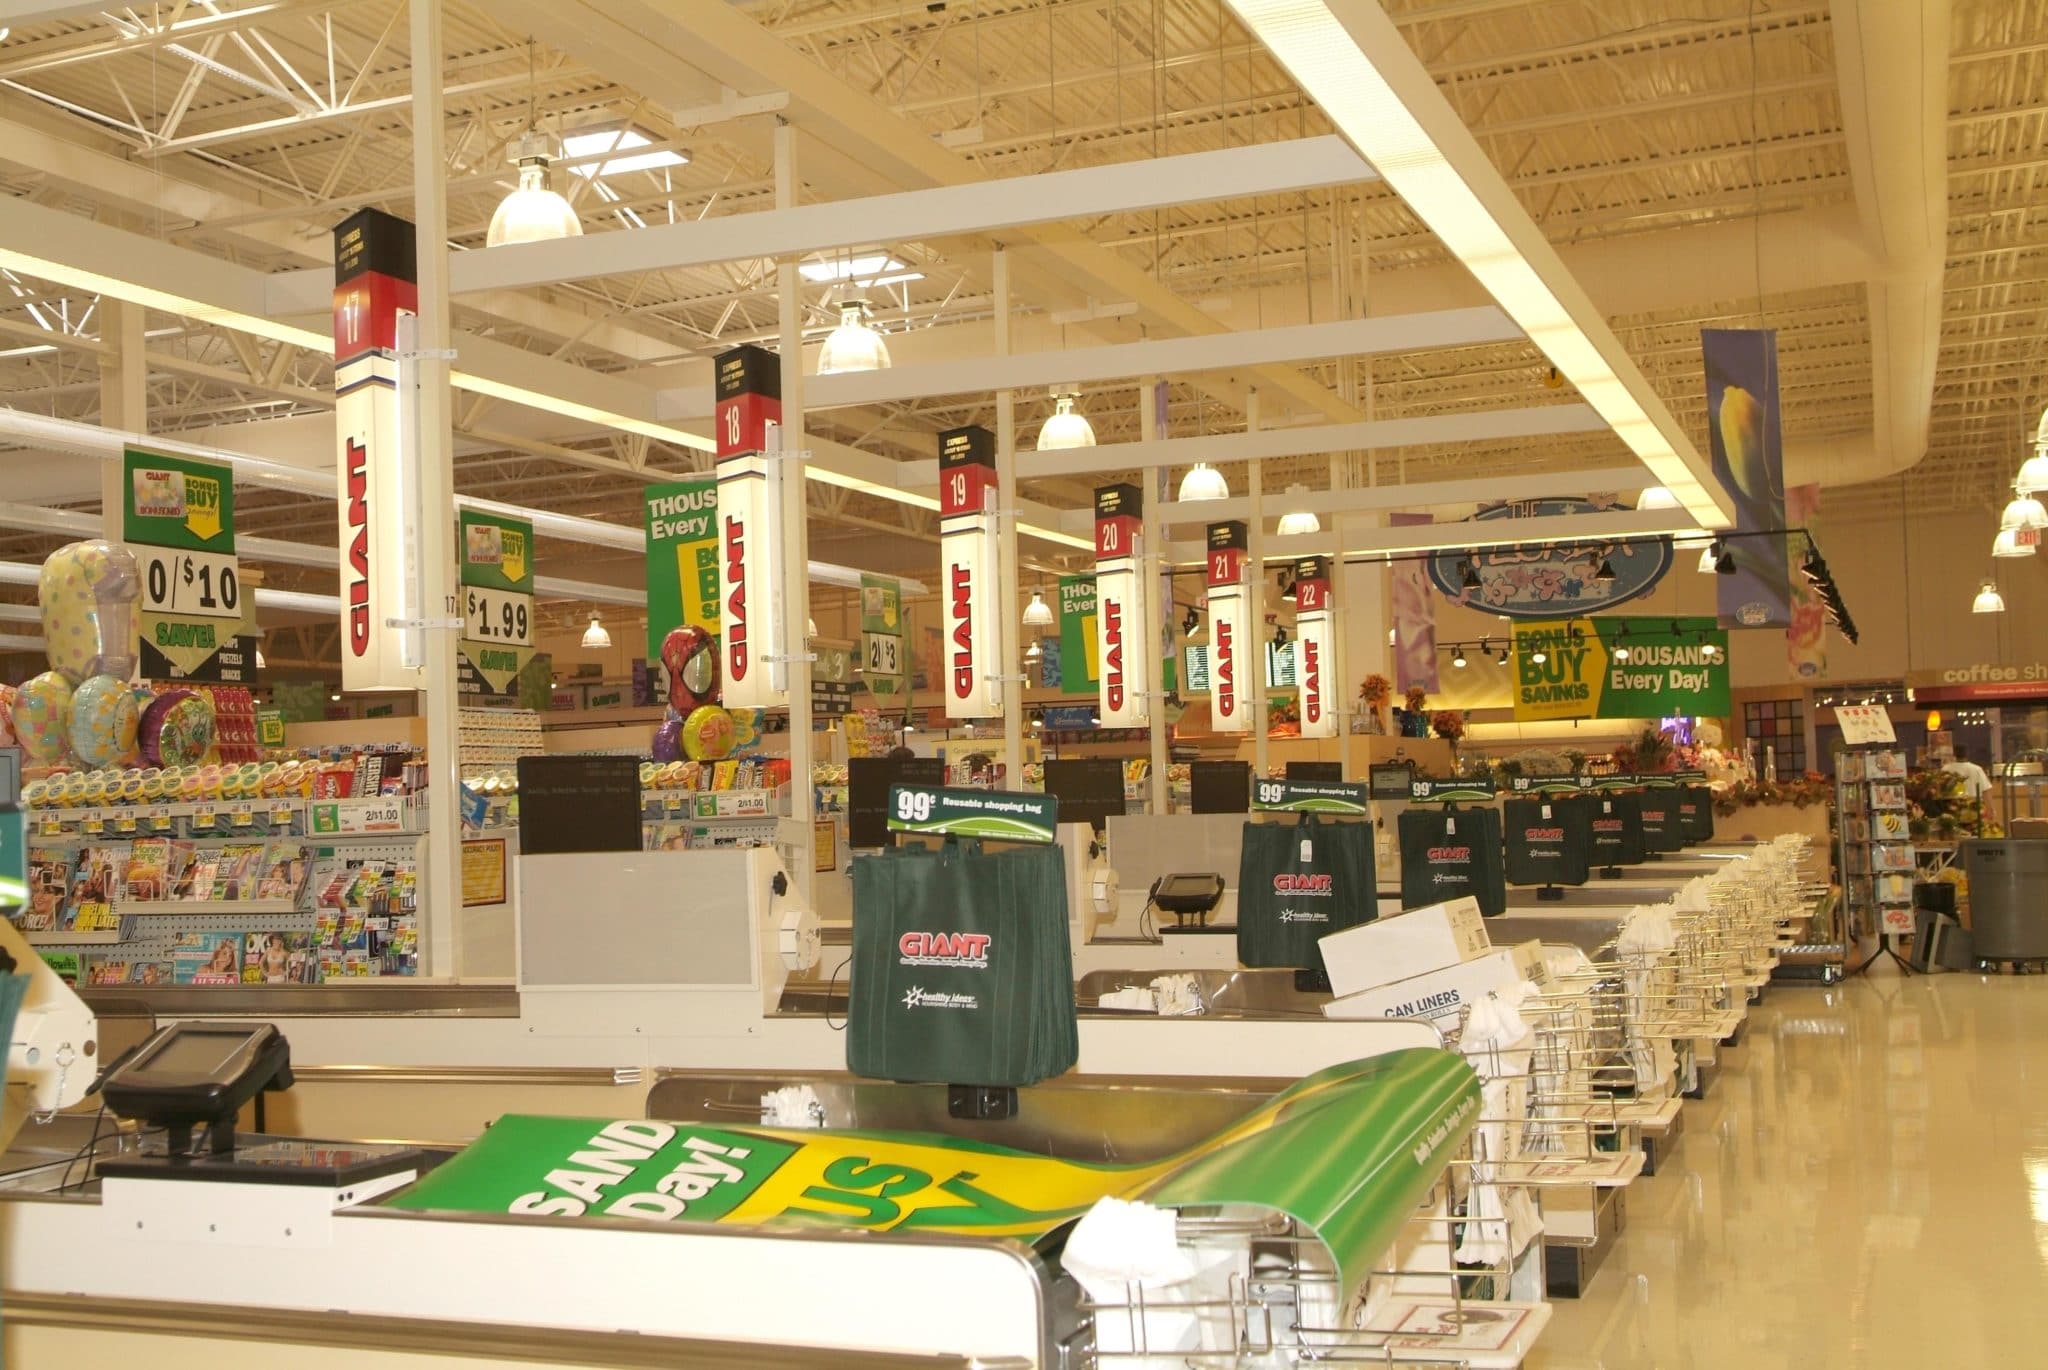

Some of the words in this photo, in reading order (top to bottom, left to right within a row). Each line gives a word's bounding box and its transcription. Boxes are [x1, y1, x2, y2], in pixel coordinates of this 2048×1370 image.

[343, 289, 360, 344] 17
[725, 405, 740, 446] 18
[185, 488, 218, 508] BUY
[950, 473, 966, 506] 19
[1510, 500, 1542, 519] THE
[651, 515, 709, 540] Every
[1103, 523, 1118, 551] 20
[346, 437, 370, 657] GIANT
[1215, 555, 1229, 579] 21
[445, 596, 455, 613] 17
[725, 515, 748, 682] GIANT
[1303, 584, 1315, 606] 22
[468, 592, 528, 640] $1.99
[155, 621, 216, 649] SAVE!
[952, 563, 974, 699] GIANT
[1515, 627, 1585, 652] BONUS
[218, 653, 243, 665] PRETZELS
[1105, 598, 1124, 712] GIANT
[1518, 648, 1586, 687] BUY
[1610, 645, 1726, 667] THOUSANDS
[1216, 619, 1234, 718] GIANT
[1305, 639, 1320, 724] GIANT
[1611, 670, 1663, 693] Every
[1669, 669, 1710, 693] Day!
[1943, 663, 2017, 683] coffee
[1521, 683, 1590, 704] SAVINGS
[365, 809, 398, 821] 2/$1.00
[943, 797, 983, 809] Reusable
[984, 800, 1024, 813] shopping
[1025, 803, 1042, 814] bag
[1427, 846, 1470, 860] GIANT
[1274, 874, 1332, 892] GIANT
[899, 932, 991, 960] GIANT
[923, 992, 951, 1003] healthy
[1384, 1002, 1414, 1018] CAN
[1416, 989, 1460, 1012] LINERS
[508, 1120, 678, 1218] SAND
[603, 1136, 752, 1222] Day!
